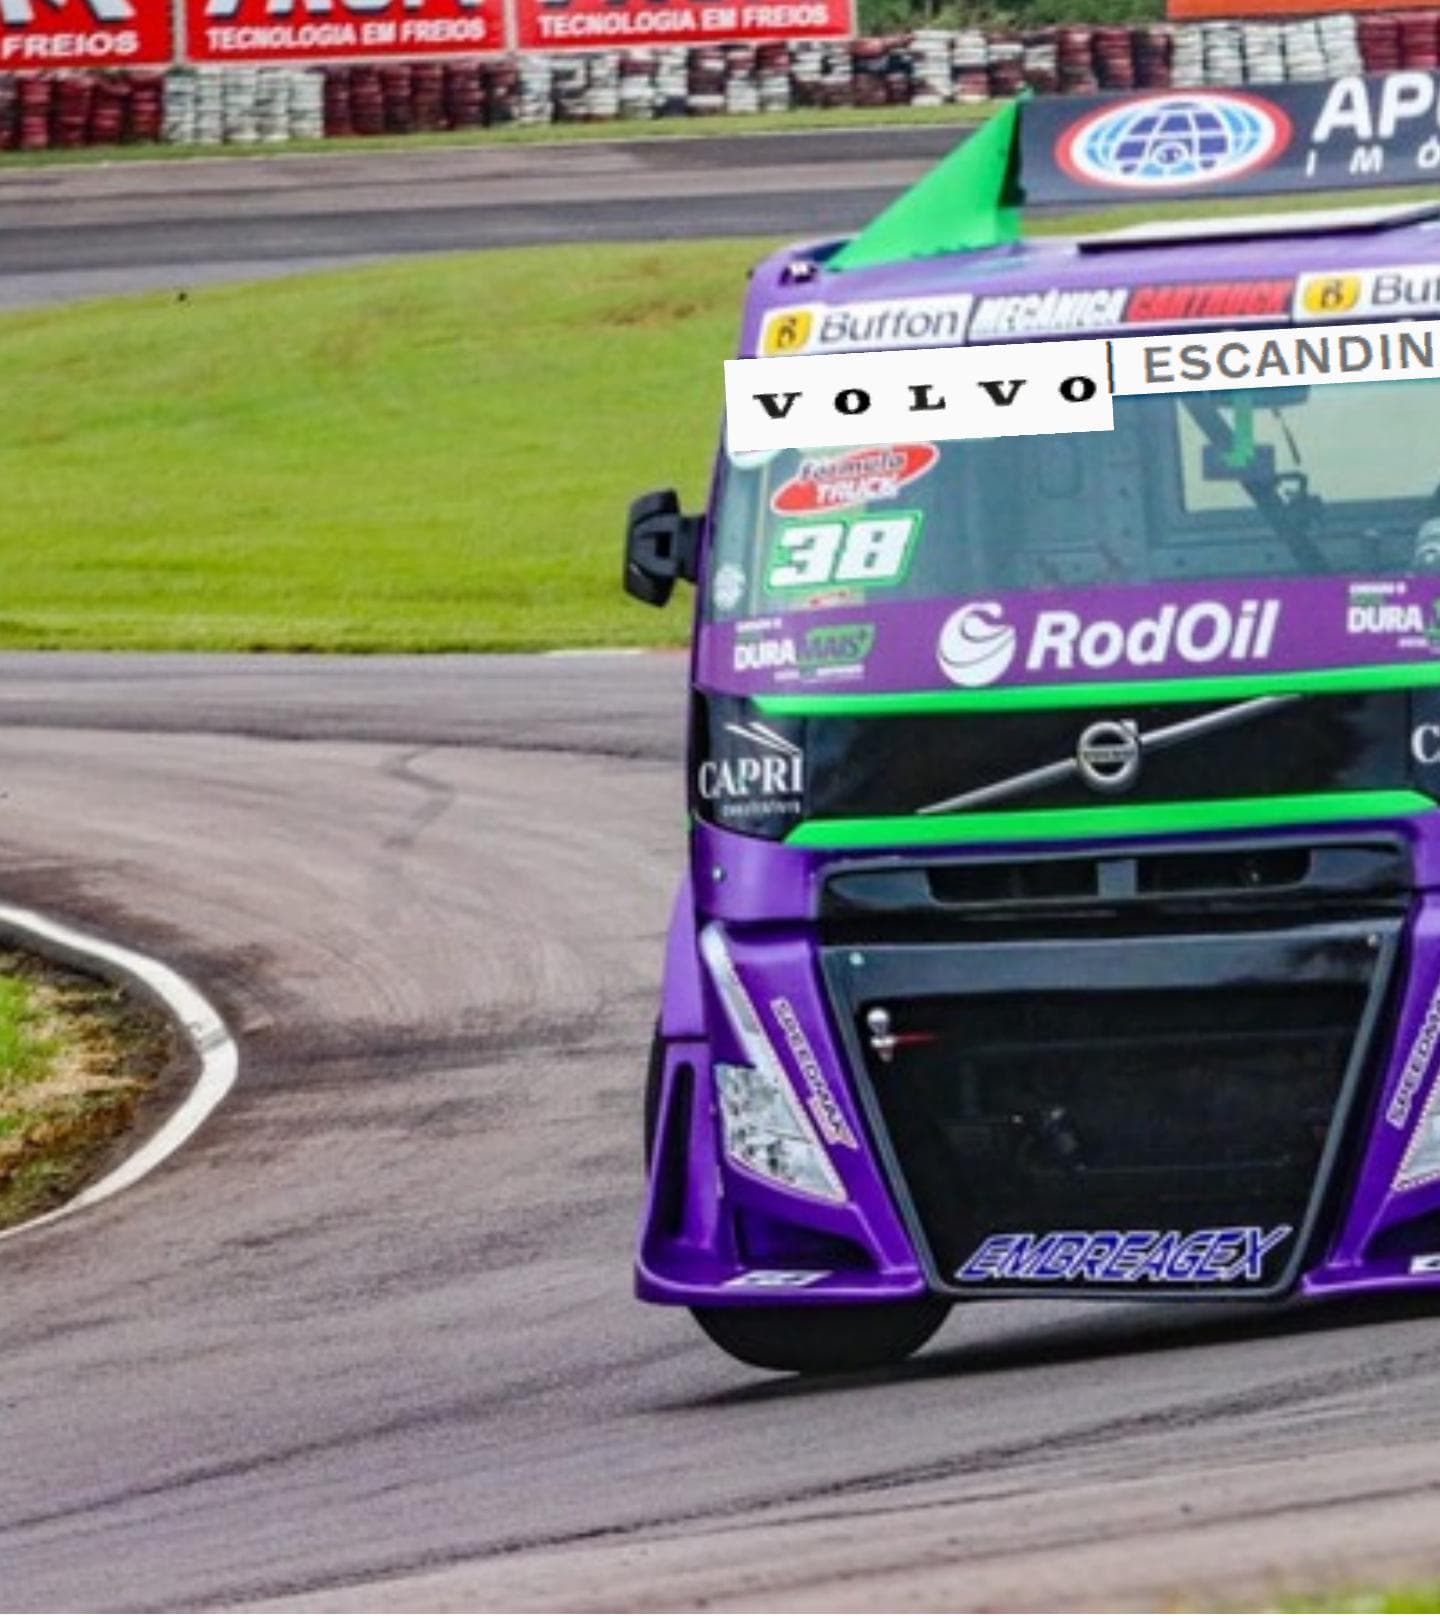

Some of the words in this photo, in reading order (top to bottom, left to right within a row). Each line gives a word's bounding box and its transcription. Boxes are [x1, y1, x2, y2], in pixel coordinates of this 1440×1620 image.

[205, 23, 355, 50] TECNOLOGIA
[362, 22, 397, 45] EM
[402, 17, 487, 43] FREIOS
[539, 9, 695, 38] TECNOLOGIA
[702, 8, 738, 30] EM
[742, 4, 829, 28] FREIOS
[1, 31, 140, 60] FREIOS
[819, 307, 959, 344] Buffon
[769, 518, 914, 587] 38
[1026, 600, 1280, 671] RodOil
[1347, 604, 1424, 633] DURA
[734, 638, 797, 671] DURA
[698, 755, 804, 799] CAPRI
[955, 1225, 1294, 1281] EMBREAGEX
